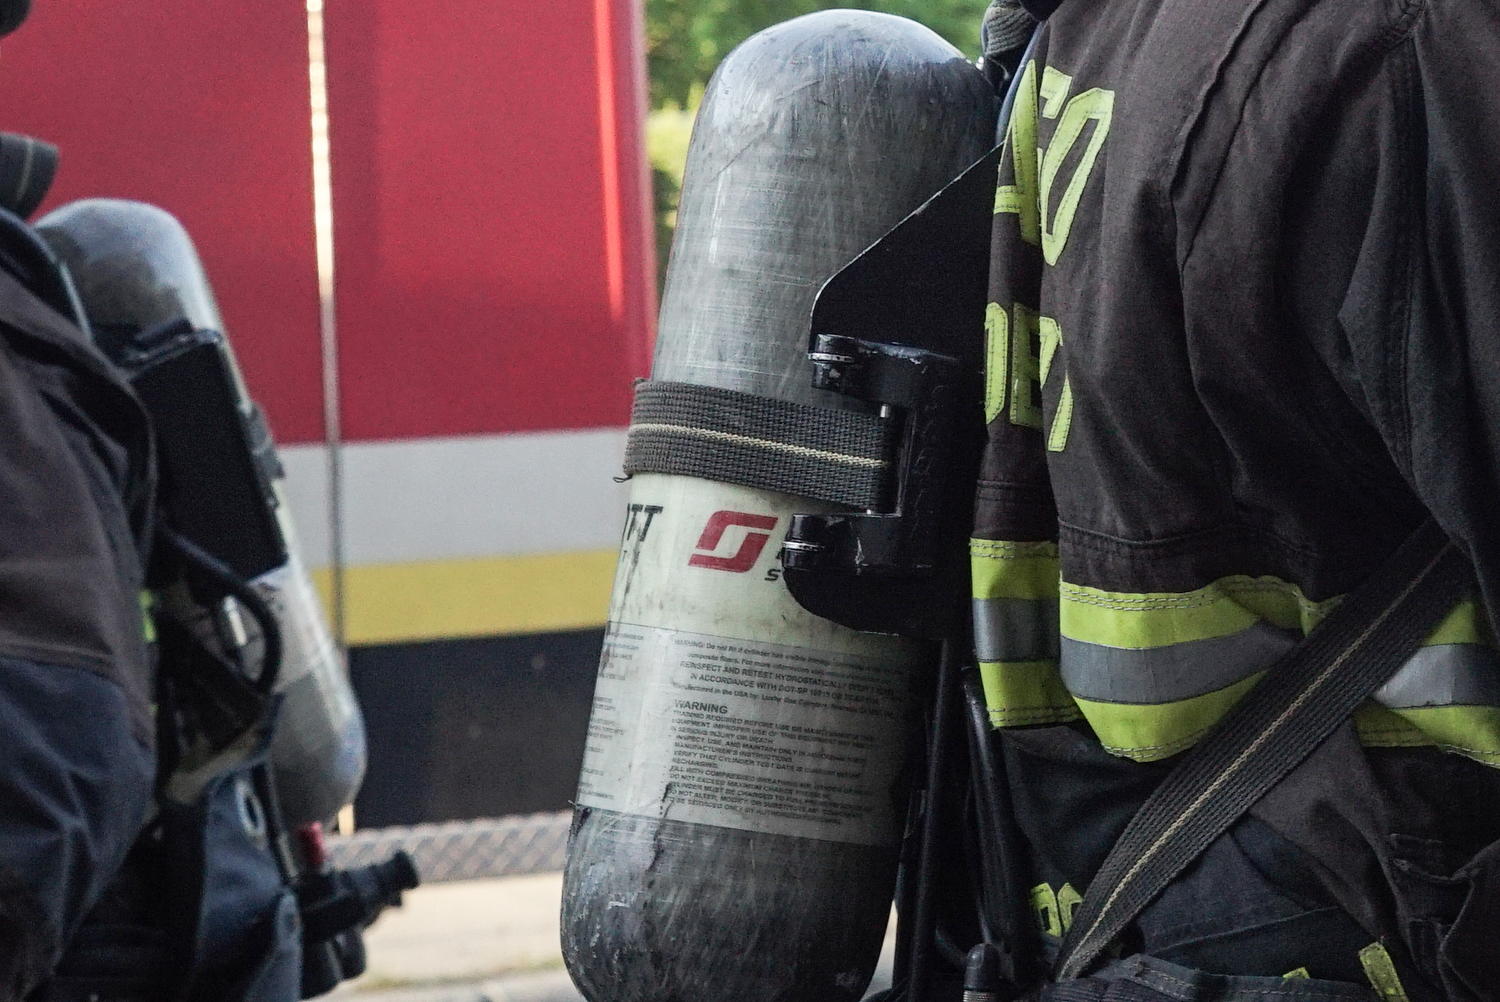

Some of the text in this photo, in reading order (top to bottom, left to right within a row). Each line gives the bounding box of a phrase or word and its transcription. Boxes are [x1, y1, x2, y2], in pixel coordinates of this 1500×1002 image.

[679, 660, 722, 672] REINSPECT
[722, 665, 740, 675] AND
[741, 668, 773, 679] RETEST
[774, 672, 846, 689] HYDROSTATICALLY
[698, 673, 754, 687] ACCORDANCE
[756, 681, 776, 690] WITH
[674, 698, 728, 714] WARNING
